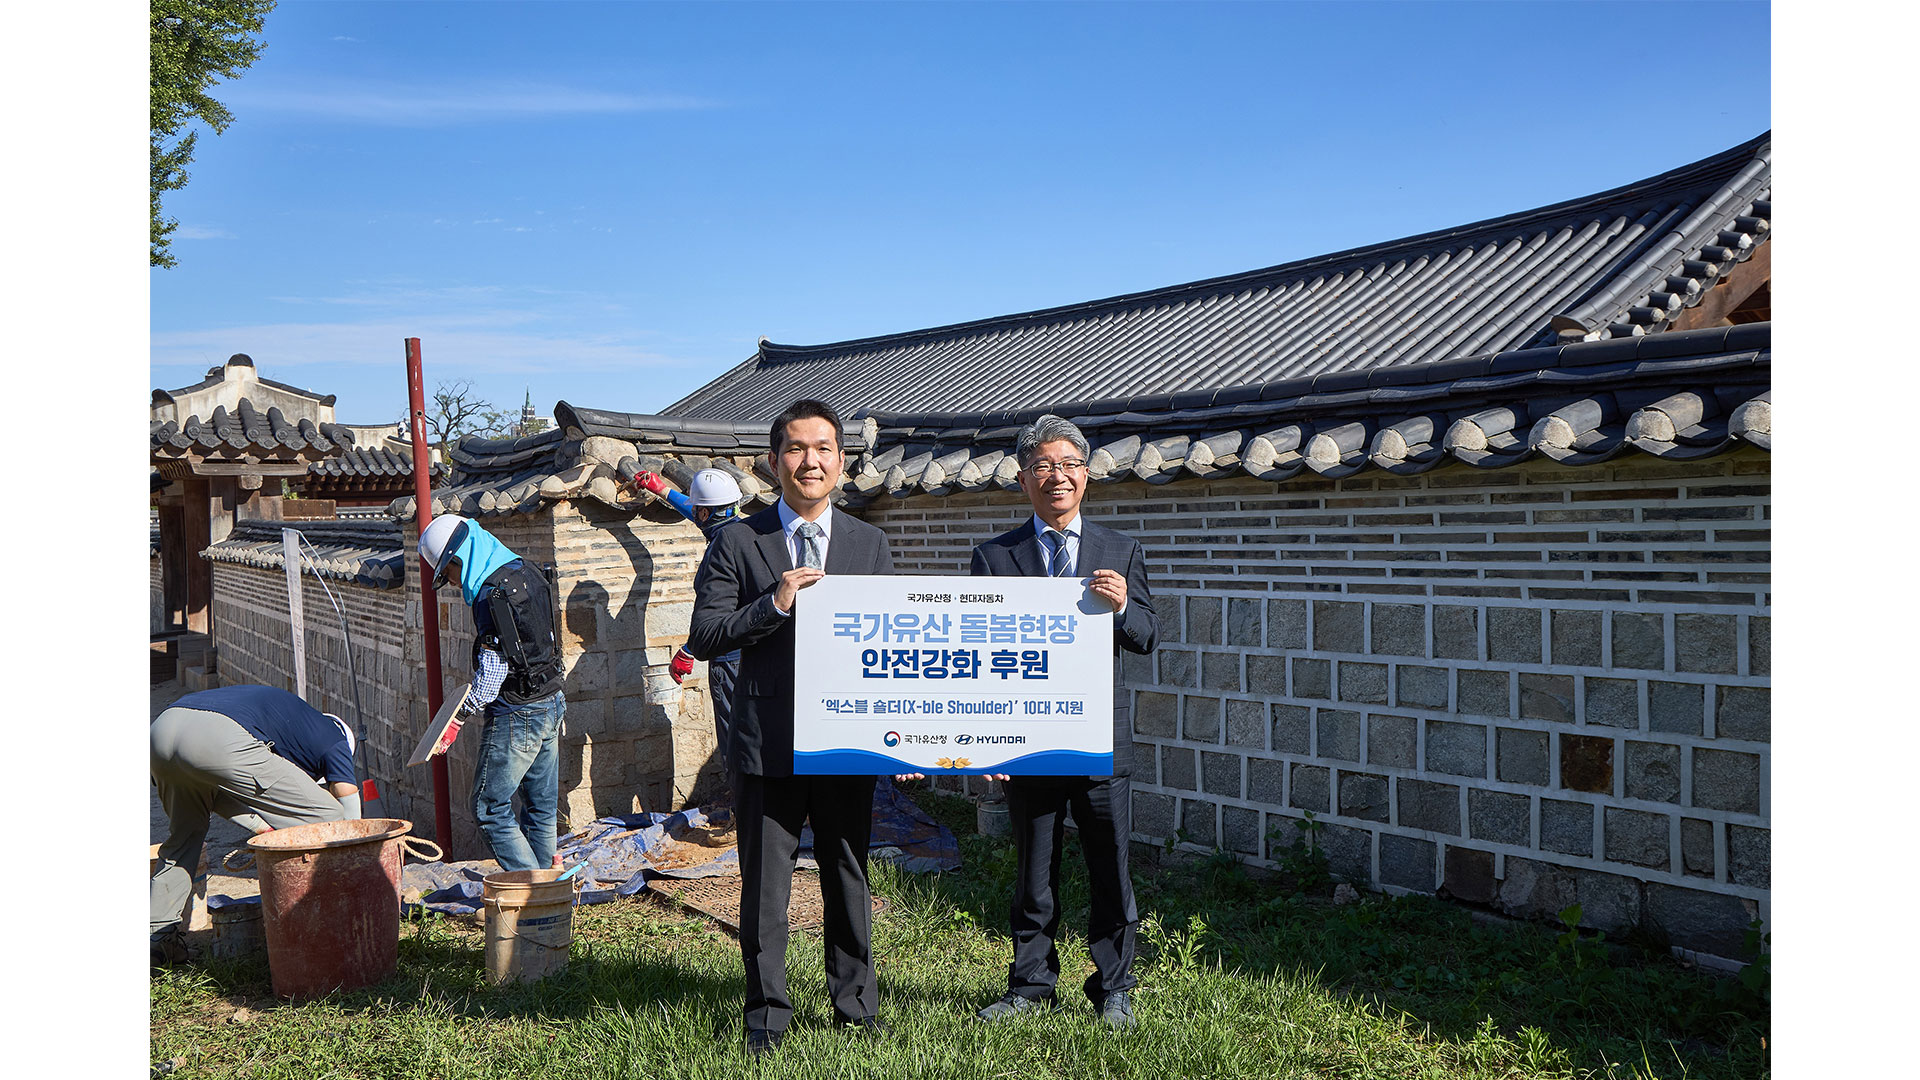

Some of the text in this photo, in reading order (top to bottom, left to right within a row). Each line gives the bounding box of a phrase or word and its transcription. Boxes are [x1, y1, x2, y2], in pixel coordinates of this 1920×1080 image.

[907, 593, 952, 603] 국가유산청
[959, 594, 1004, 604] 현대자동차
[833, 612, 1078, 645] 국가유산 돌봄현장
[861, 648, 1049, 680] 안전강화 후원
[873, 699, 944, 715] 숄더(X-ble
[1023, 701, 1051, 715] 10대
[1055, 700, 1084, 715] 지원
[904, 734, 948, 744] 국가유산청
[976, 735, 1026, 744] HYUNDAI
